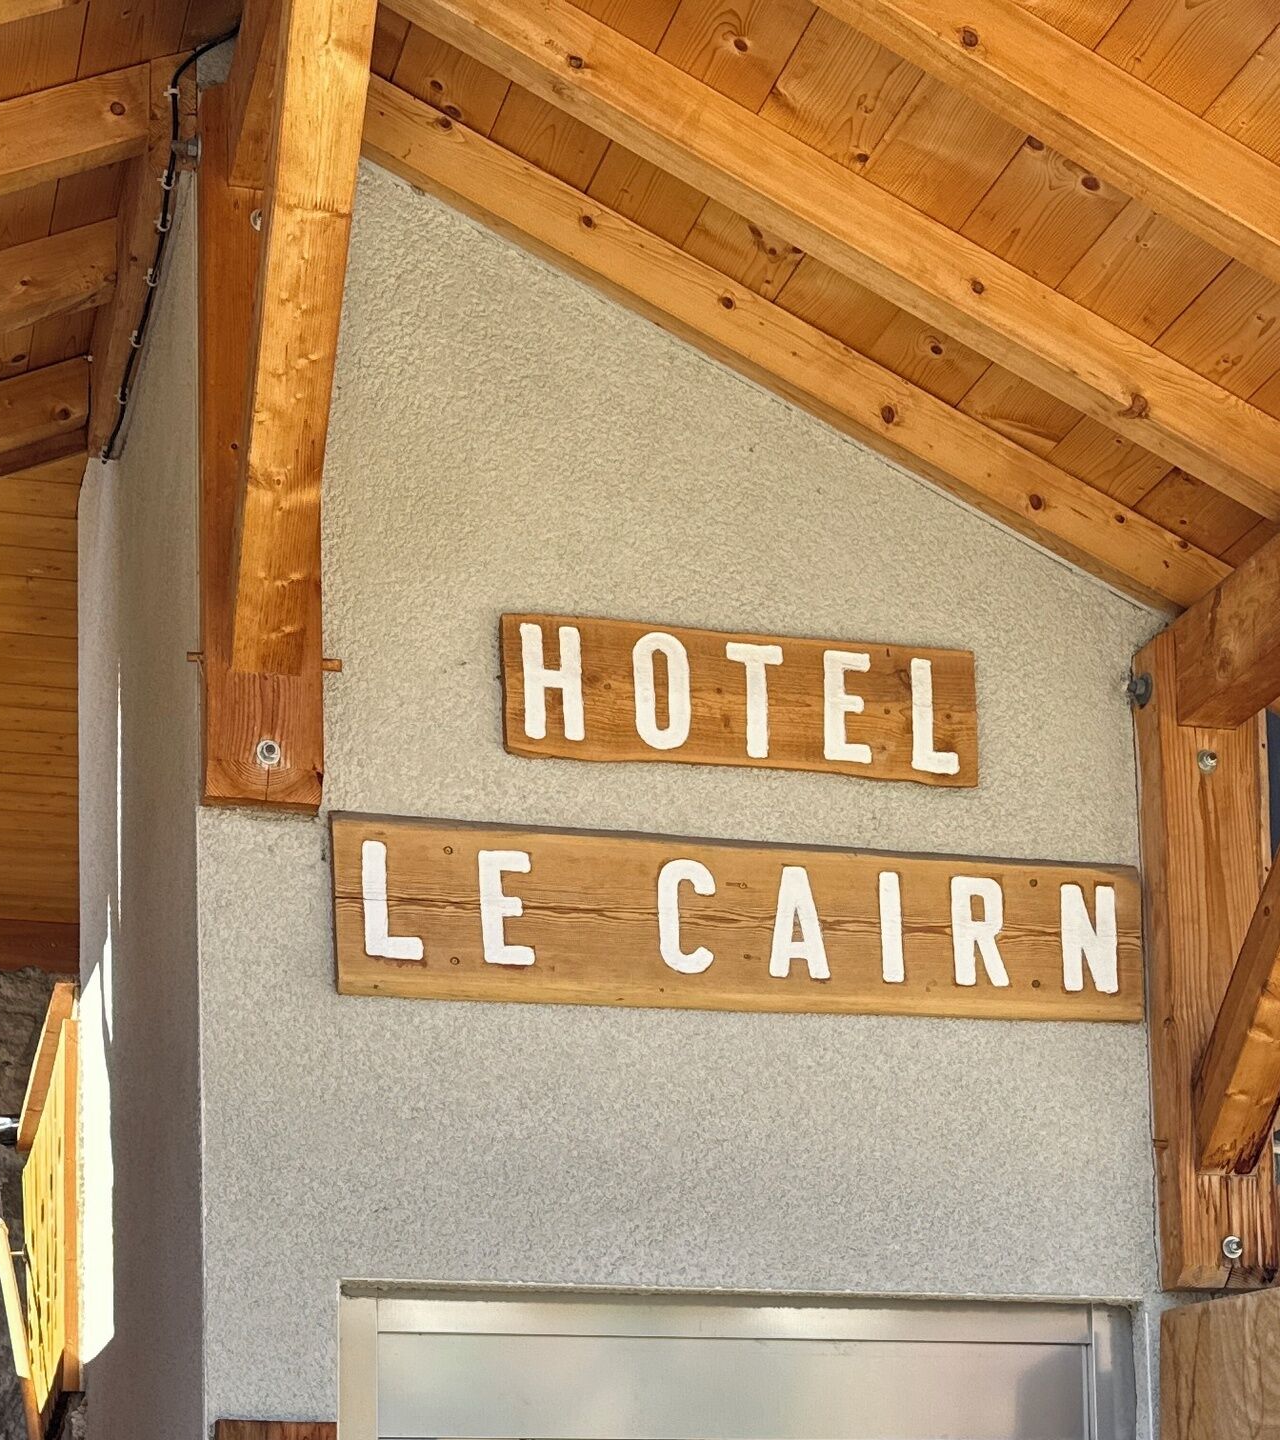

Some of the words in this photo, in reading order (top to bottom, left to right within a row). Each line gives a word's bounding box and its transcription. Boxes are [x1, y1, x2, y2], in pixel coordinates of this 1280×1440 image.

[519, 623, 960, 776] HOTEL
[362, 840, 536, 966] LE
[657, 858, 1120, 994] CAIRN
